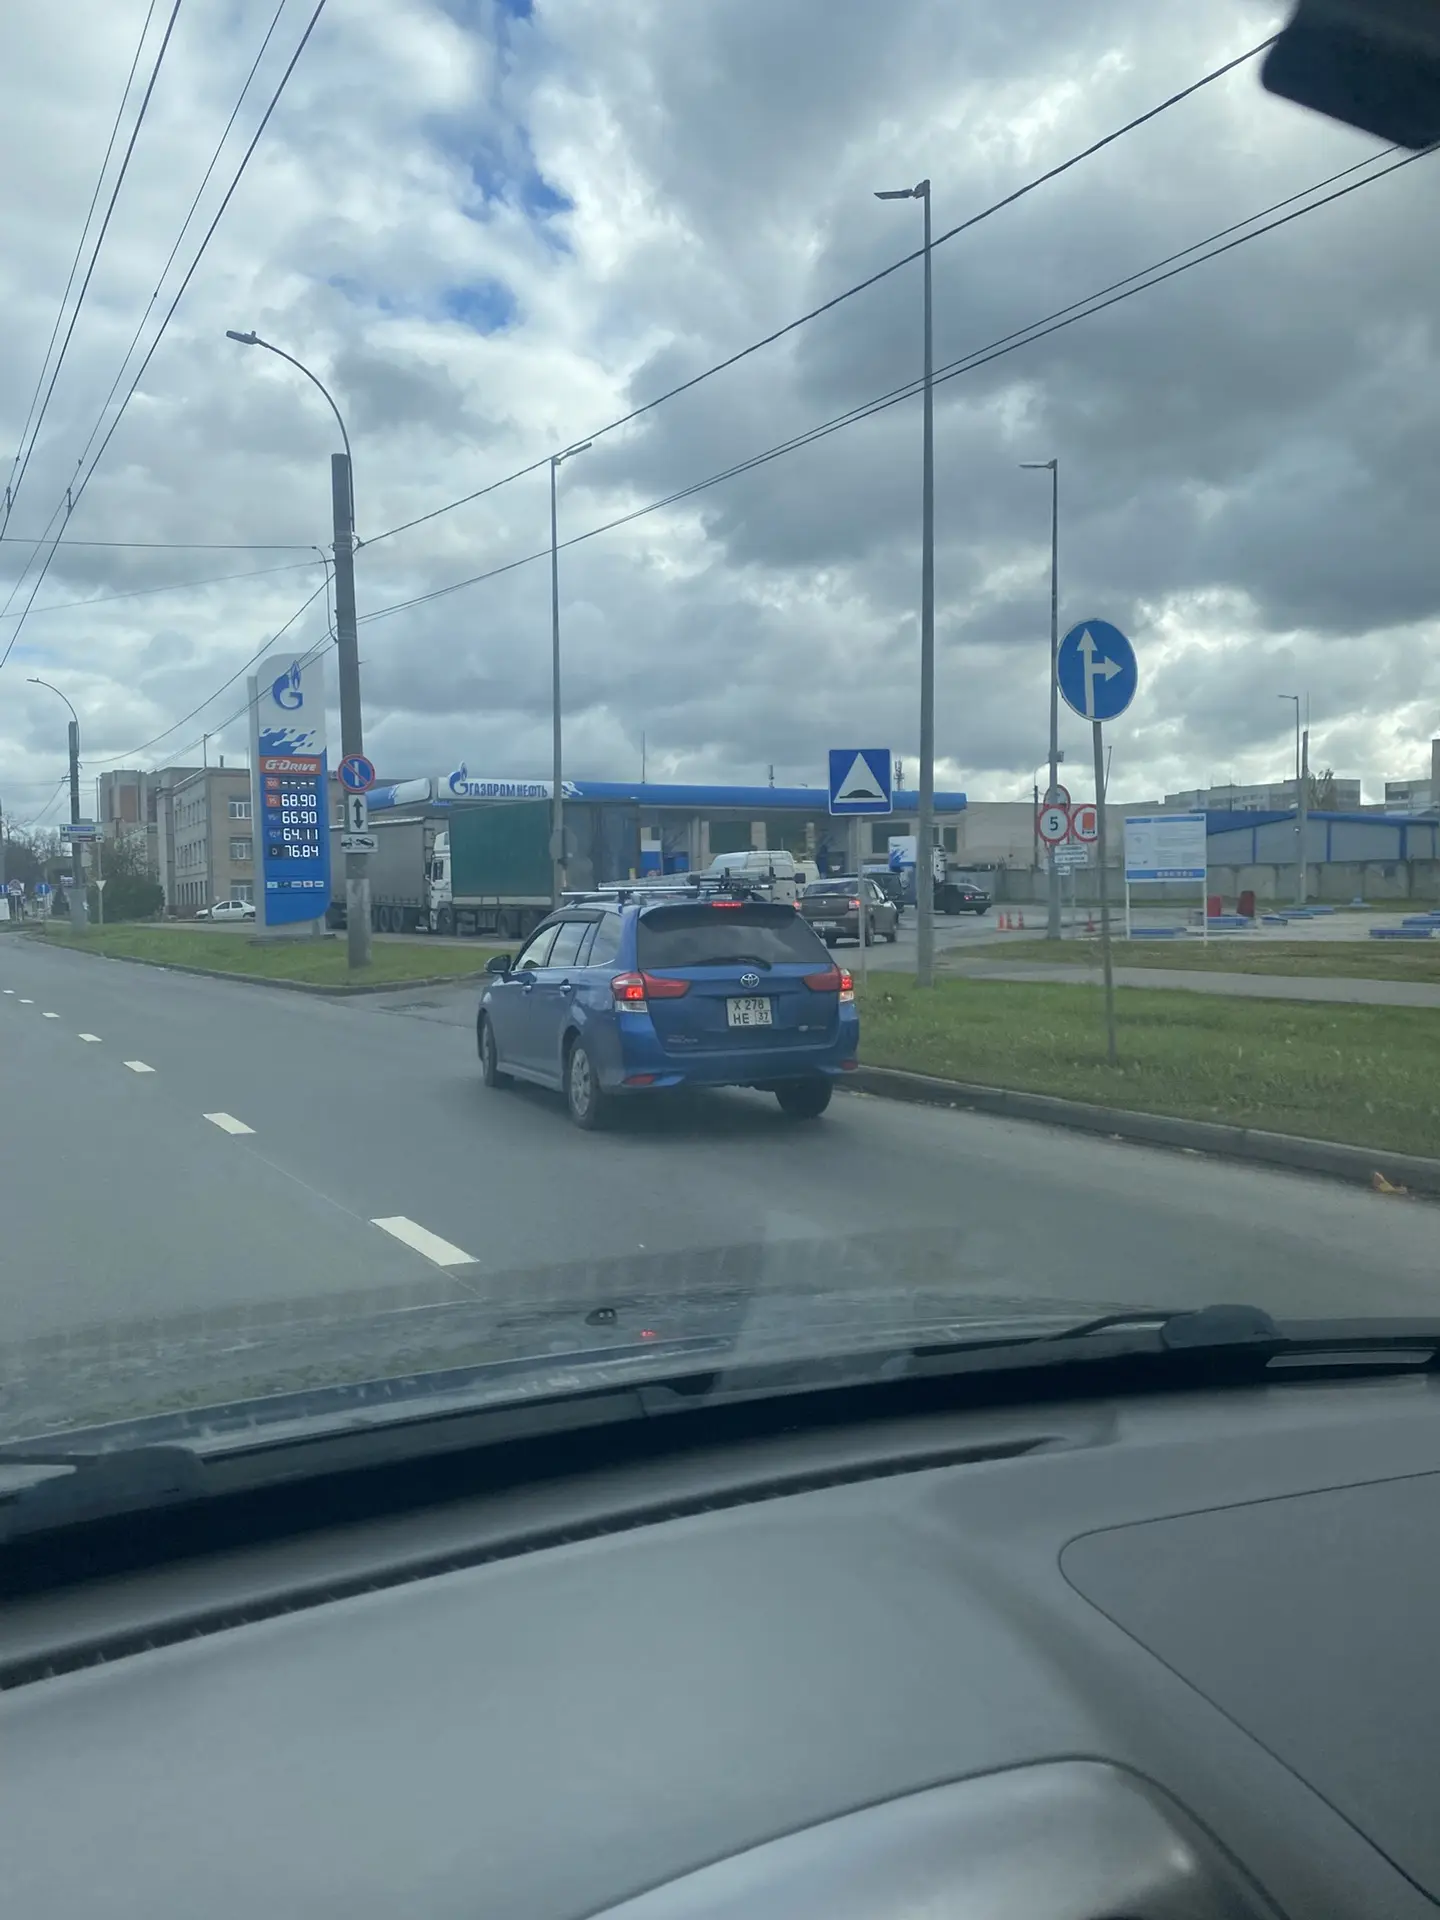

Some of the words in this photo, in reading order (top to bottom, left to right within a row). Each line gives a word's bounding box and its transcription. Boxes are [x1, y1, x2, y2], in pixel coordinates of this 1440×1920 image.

[469, 782, 548, 798] ГАЗПРОМНЕФТЬ
[281, 794, 317, 807] 68.90
[282, 811, 317, 824] 66.90
[1050, 816, 1059, 831] 5
[283, 828, 318, 841] 64.11
[285, 845, 319, 858] 76.84
[745, 999, 764, 1010] 278
[759, 1012, 769, 1021] 37
